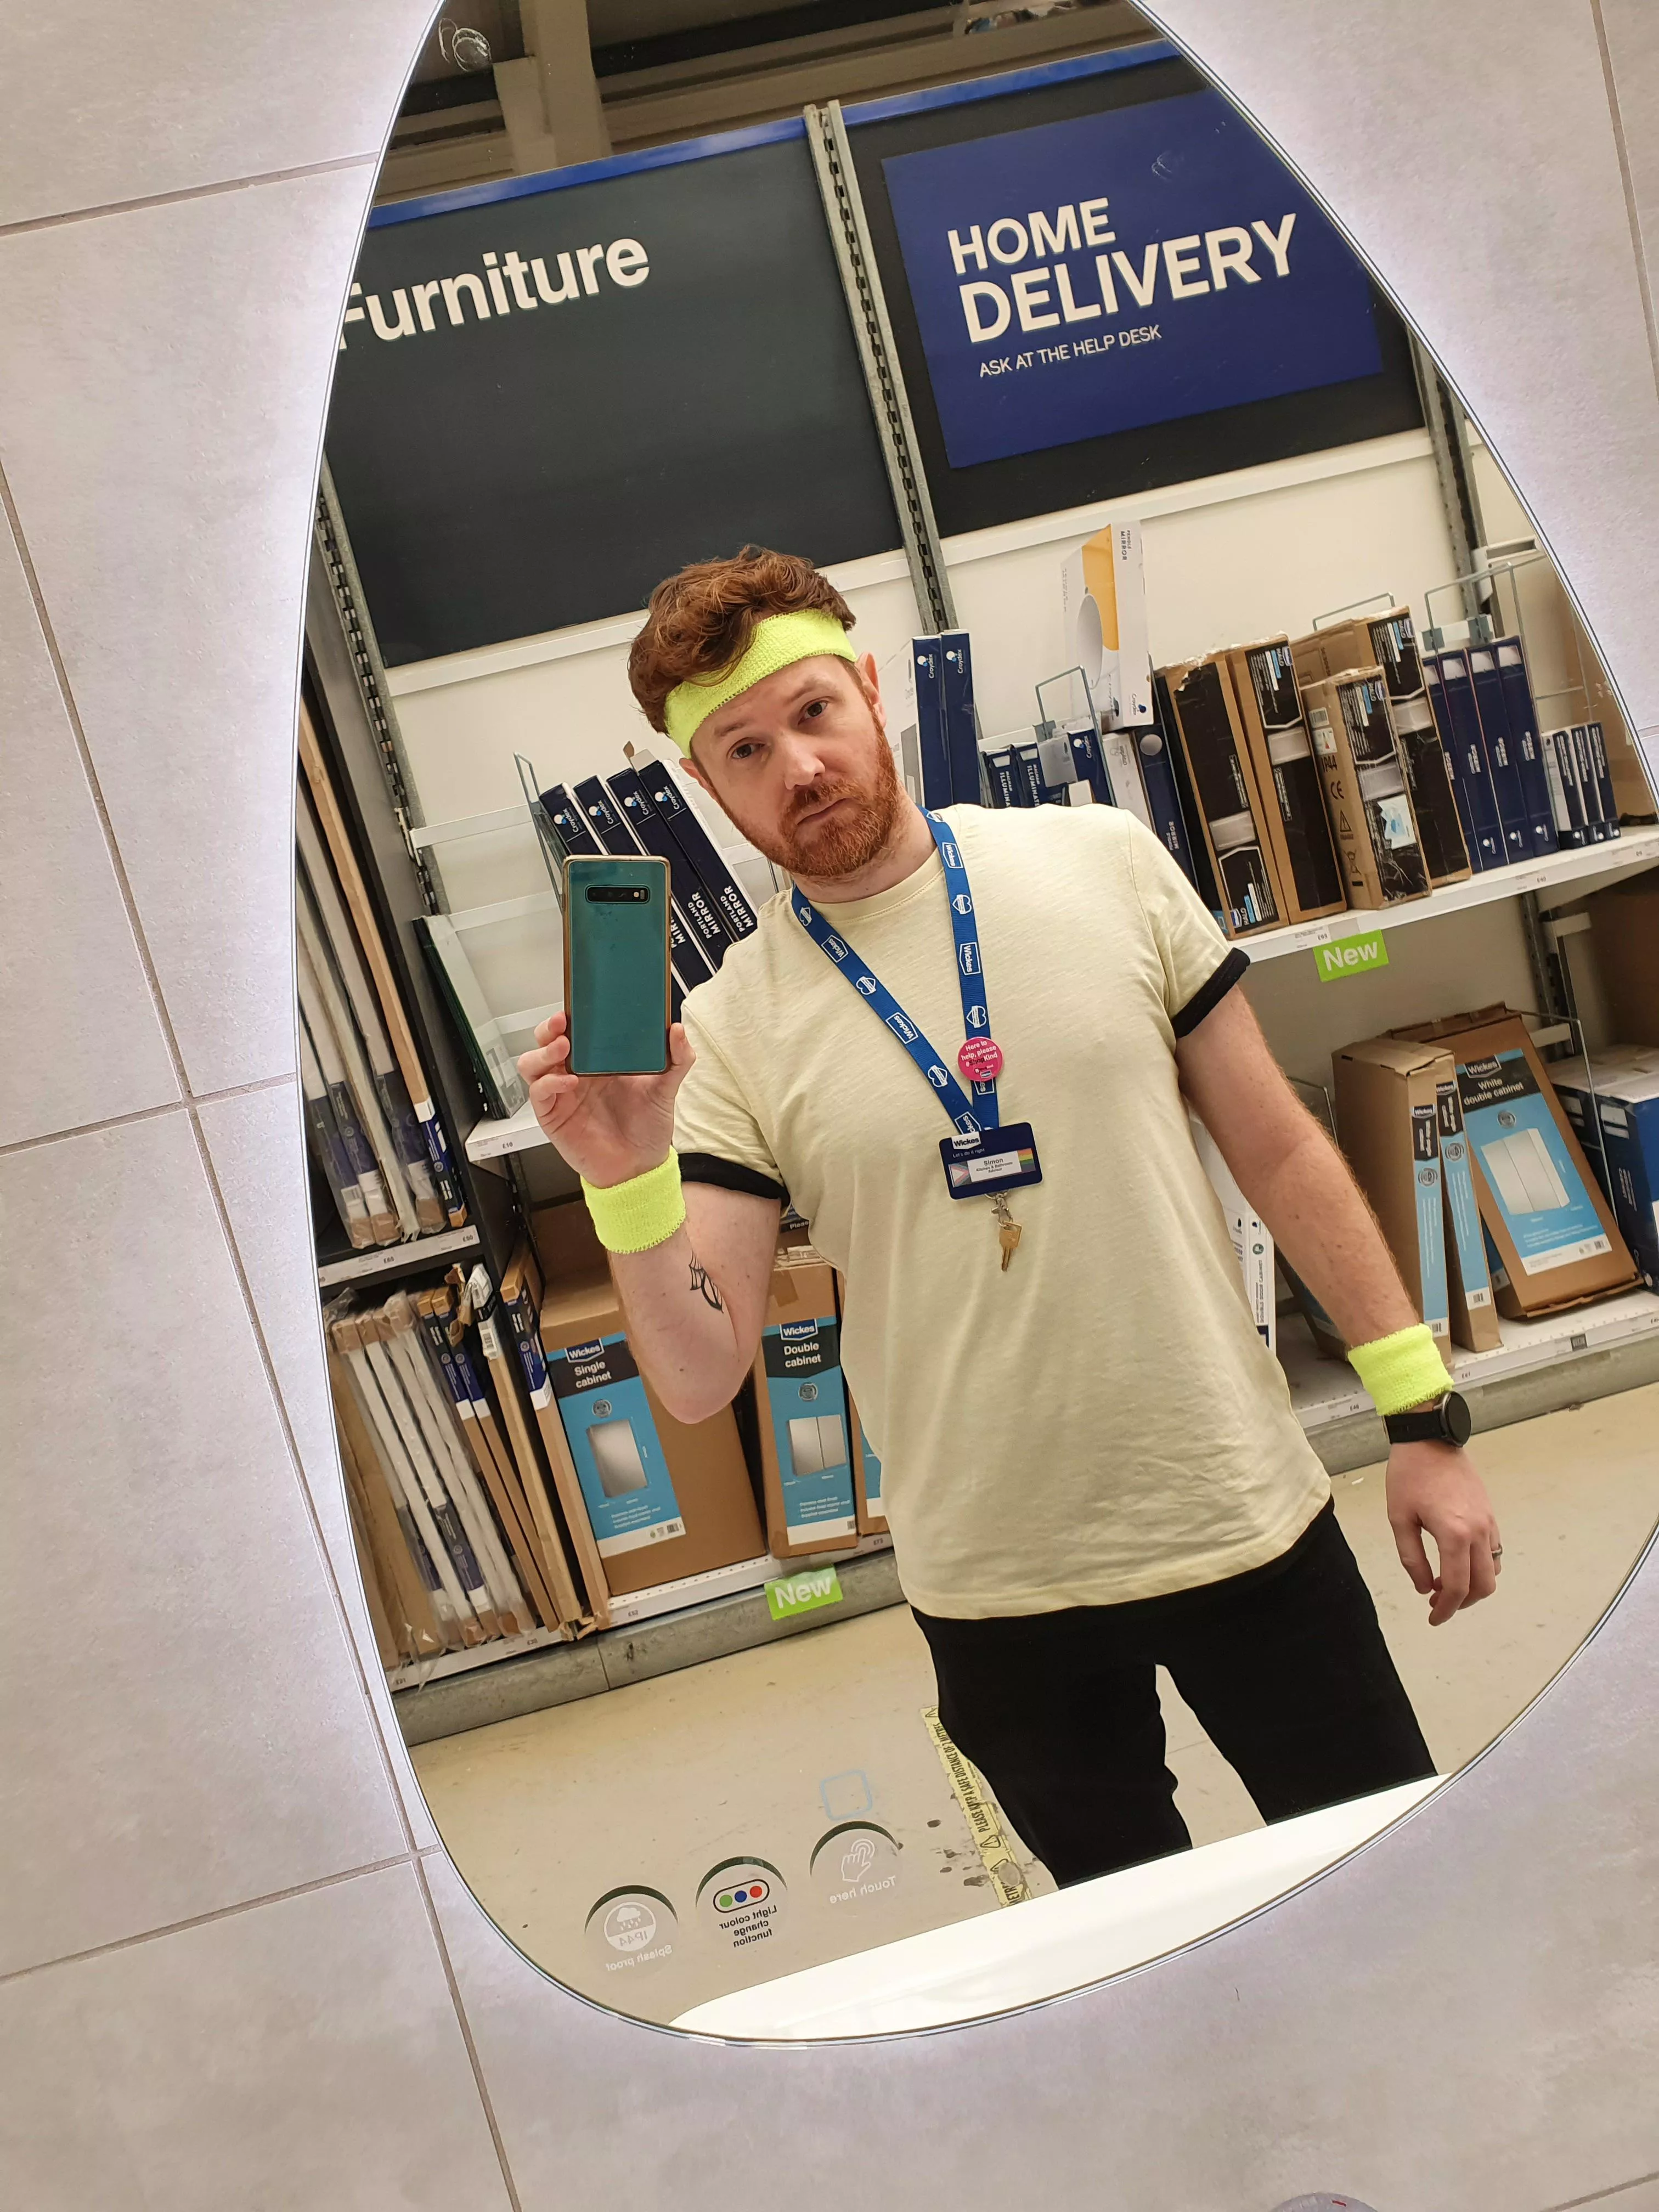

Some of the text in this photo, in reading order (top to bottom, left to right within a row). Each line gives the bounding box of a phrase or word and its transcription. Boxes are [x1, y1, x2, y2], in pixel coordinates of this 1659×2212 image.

[948, 197, 1117, 276] HOME
[958, 213, 1297, 343] DELIVERY
[338, 237, 650, 351] Furniture
[979, 324, 1162, 378] ASK AT THE HELP DESK
[1321, 755, 1338, 772] IP44
[663, 786, 680, 810] Croydex
[1000, 772, 1011, 807] ILLUMINA
[597, 800, 614, 825] Croydex
[633, 791, 649, 815] Croydex
[562, 808, 579, 833] Croydex
[945, 844, 956, 866] Wickes
[691, 892, 721, 935] MIRROR
[720, 895, 746, 933] PORTLAND
[724, 885, 754, 928] MIRROR
[671, 917, 686, 944] MIR
[687, 902, 713, 939] PORTLAND
[963, 945, 973, 973] Wickes
[1323, 941, 1378, 972] New
[894, 1015, 914, 1040] Wickes
[961, 1046, 997, 1061] help, please
[966, 1043, 980, 1052] Here
[1468, 1060, 1498, 1075] Wickes
[1463, 1082, 1525, 1107] double cabinet
[1477, 1078, 1503, 1091] White
[963, 1115, 975, 1133] ckes
[502, 1142, 514, 1150] £10
[953, 1137, 980, 1147] Wickes
[984, 1158, 1003, 1166] Simon
[790, 1221, 809, 1230] Pleas
[783, 1325, 815, 1337] Wickes
[568, 1344, 601, 1359] Wickes
[783, 1342, 820, 1356] Double
[785, 1353, 822, 1368] cabinet
[574, 1361, 606, 1376] Single
[575, 1370, 612, 1389] cabinet
[775, 1576, 831, 1609] New
[943, 1745, 956, 1754] OF
[946, 1752, 967, 1778] DISTANCE
[957, 1777, 973, 1792] SAFE
[971, 1809, 991, 1833] PLEASE
